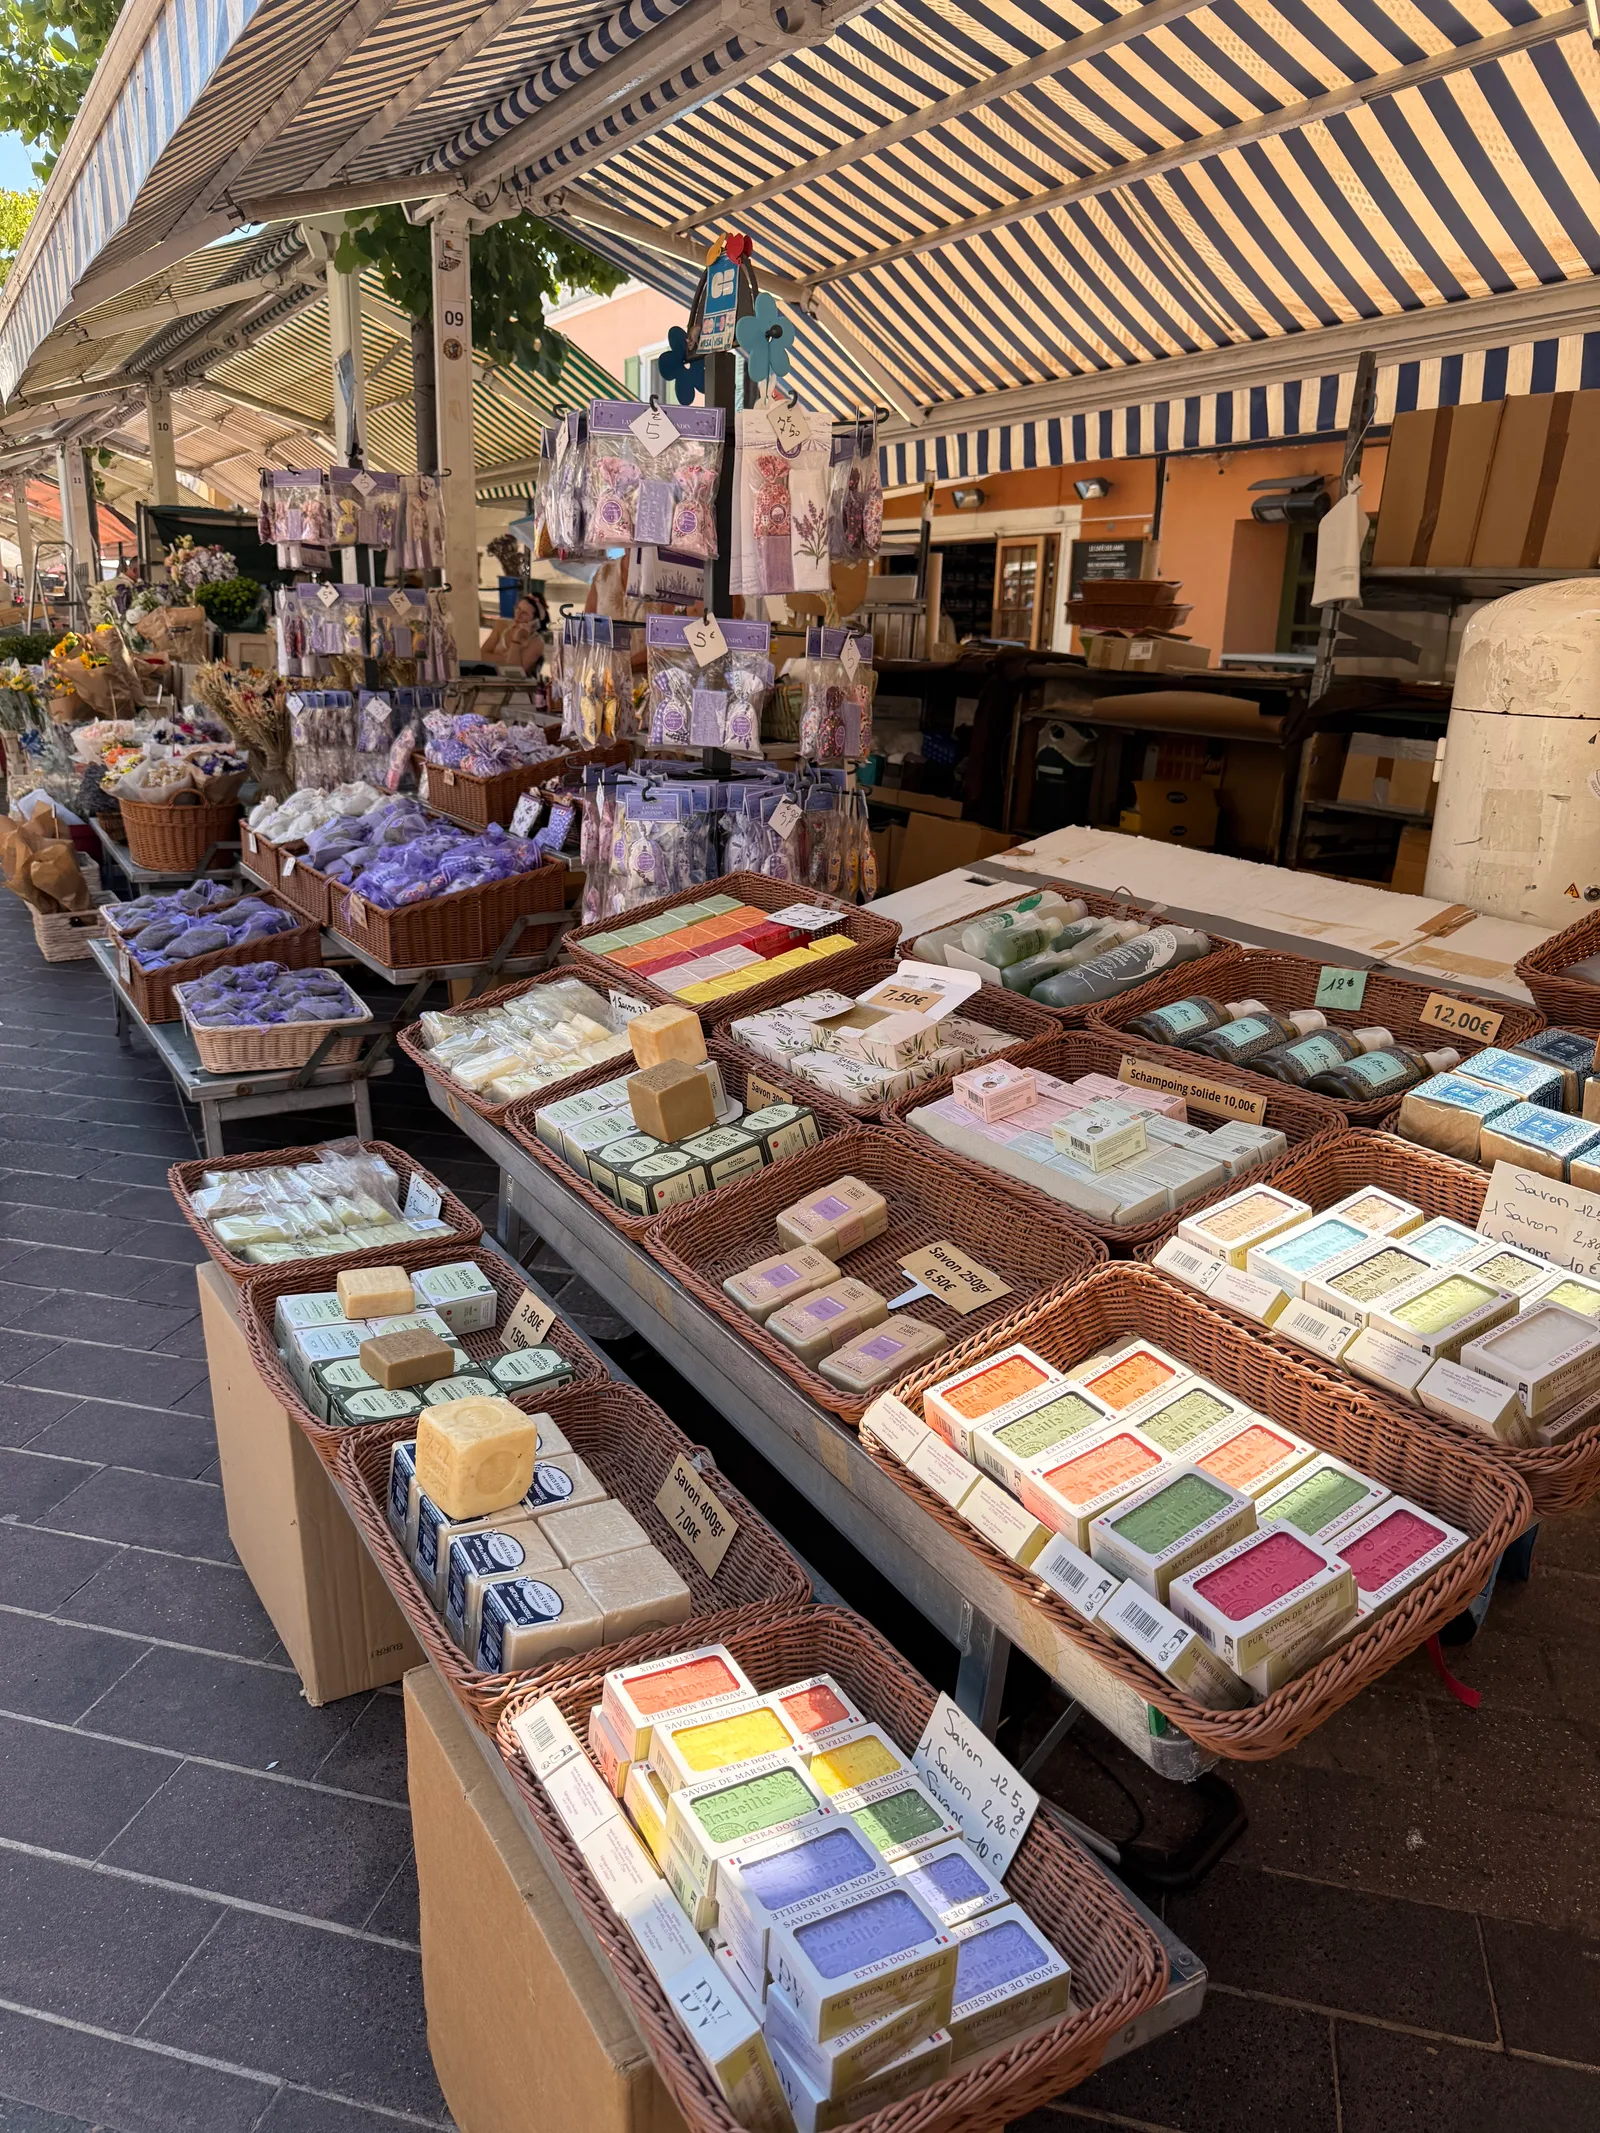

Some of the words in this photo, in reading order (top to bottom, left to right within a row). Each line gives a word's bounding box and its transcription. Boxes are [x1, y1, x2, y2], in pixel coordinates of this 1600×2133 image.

[445, 310, 464, 326] 09
[157, 423, 169, 431] 10
[882, 989, 929, 1006] 7,50€
[1433, 1004, 1494, 1036] 12,00€
[751, 1082, 771, 1099] Savon
[1130, 1069, 1188, 1096] Schampoing
[1190, 1085, 1221, 1103] Solide
[1223, 1094, 1257, 1114] 10,00€
[1515, 1174, 1570, 1209] Savon
[1503, 1202, 1559, 1234] Savon
[924, 1268, 957, 1292] 6,50€
[929, 1246, 962, 1272] Savon
[958, 1270, 992, 1294] 250gr
[521, 1305, 544, 1332] 3,80€
[1451, 1316, 1475, 1330] EXTRA
[1474, 1304, 1494, 1317] DOUX
[1471, 1332, 1497, 1348] SAVON
[1498, 1323, 1510, 1332] DE
[1512, 1302, 1549, 1326] MARSEILLE
[1548, 1352, 1573, 1367] EXTRA
[1573, 1340, 1592, 1353] DOUX
[1045, 1440, 1071, 1455] EXTRA
[1072, 1427, 1095, 1441] DOUX
[1148, 1461, 1172, 1477] SAVON
[1282, 1459, 1325, 1492] MARSEILLE
[1079, 1481, 1131, 1512] MARSEILLE
[1145, 1477, 1170, 1495] EXTRA
[674, 1467, 700, 1507] Savon
[699, 1501, 726, 1538] 400gr
[1120, 1495, 1144, 1512] DOUX
[1215, 1499, 1245, 1520] SAVON
[675, 1506, 701, 1544] 7,00€
[1202, 1518, 1216, 1529] DE
[1318, 1519, 1342, 1539] EXTRA
[1342, 1504, 1364, 1520] DOUX
[1356, 1514, 1381, 1531] EXTRA
[1155, 1526, 1204, 1562] MARSEILLE
[1170, 1549, 1205, 1572] MARSEILLE
[1207, 1536, 1225, 1550] FINE
[1225, 1518, 1243, 1534] SOAP
[1333, 1531, 1356, 1549] DOUX
[1434, 1537, 1459, 1556] SAVON
[505, 1550, 516, 1564] FABRE
[1182, 1564, 1215, 1584] SAVON
[1216, 1554, 1230, 1565] DE
[1231, 1524, 1281, 1555] MARSEILLE
[1420, 1555, 1433, 1566] DE
[1373, 1563, 1421, 1600] MARSEILLE
[543, 1598, 555, 1613] FABRE
[1261, 1598, 1289, 1617] EXTRA
[1292, 1581, 1317, 1599] DOUX
[1247, 1632, 1264, 1648] PUR
[1265, 1619, 1292, 1637] SAVON
[1292, 1610, 1303, 1620] DE
[1304, 1581, 1345, 1611] MARSEILLE
[640, 1660, 665, 1673] DOUX
[665, 1653, 695, 1666] EXTRA
[715, 1689, 747, 1704] SAVON
[777, 1678, 825, 1697] MARSEILLE
[642, 1703, 698, 1723] MARSEILLE
[664, 1714, 699, 1731] SAVON
[700, 1710, 714, 1722] DE
[714, 1697, 770, 1719] MARSEILLE
[699, 1700, 714, 1710] DE
[811, 1724, 837, 1739] DOUX
[943, 1707, 983, 1769] Savon
[718, 1760, 750, 1774] EXTRA
[750, 1752, 778, 1766] DOUX
[933, 1746, 973, 1802] Savon
[680, 1781, 717, 1799] SAVON
[719, 1775, 734, 1787] DE
[734, 1757, 790, 1783] MARSEILLE
[848, 1798, 862, 1809] DE
[864, 1780, 913, 1803] MARSEILLE
[742, 1828, 777, 1844] EXTRA
[777, 1818, 804, 1834] DOUX
[967, 1837, 989, 1858] 10
[834, 1883, 850, 1896] DE
[850, 1870, 887, 1888] SAVON
[770, 1891, 831, 1921] MARSEILLE
[783, 1908, 821, 1928] SAVON
[823, 1903, 839, 1915] DE
[840, 1880, 900, 1906] MARSEILLE
[853, 1962, 889, 1979] EXTRA
[890, 1948, 921, 1965] DOUX
[1029, 1963, 1060, 1985] SAVON
[831, 1995, 850, 2011] PUR
[852, 1982, 884, 2004] SAVON
[885, 1979, 897, 1991] DE
[901, 1957, 948, 1982] MARSEILLE
[1011, 1979, 1025, 1991] DE
[952, 1986, 1008, 2018] MARSEILLE
[963, 2008, 1010, 2033] MARSEILLE
[1011, 1999, 1030, 2013] FINE
[1032, 1987, 1053, 2002] SOAP
